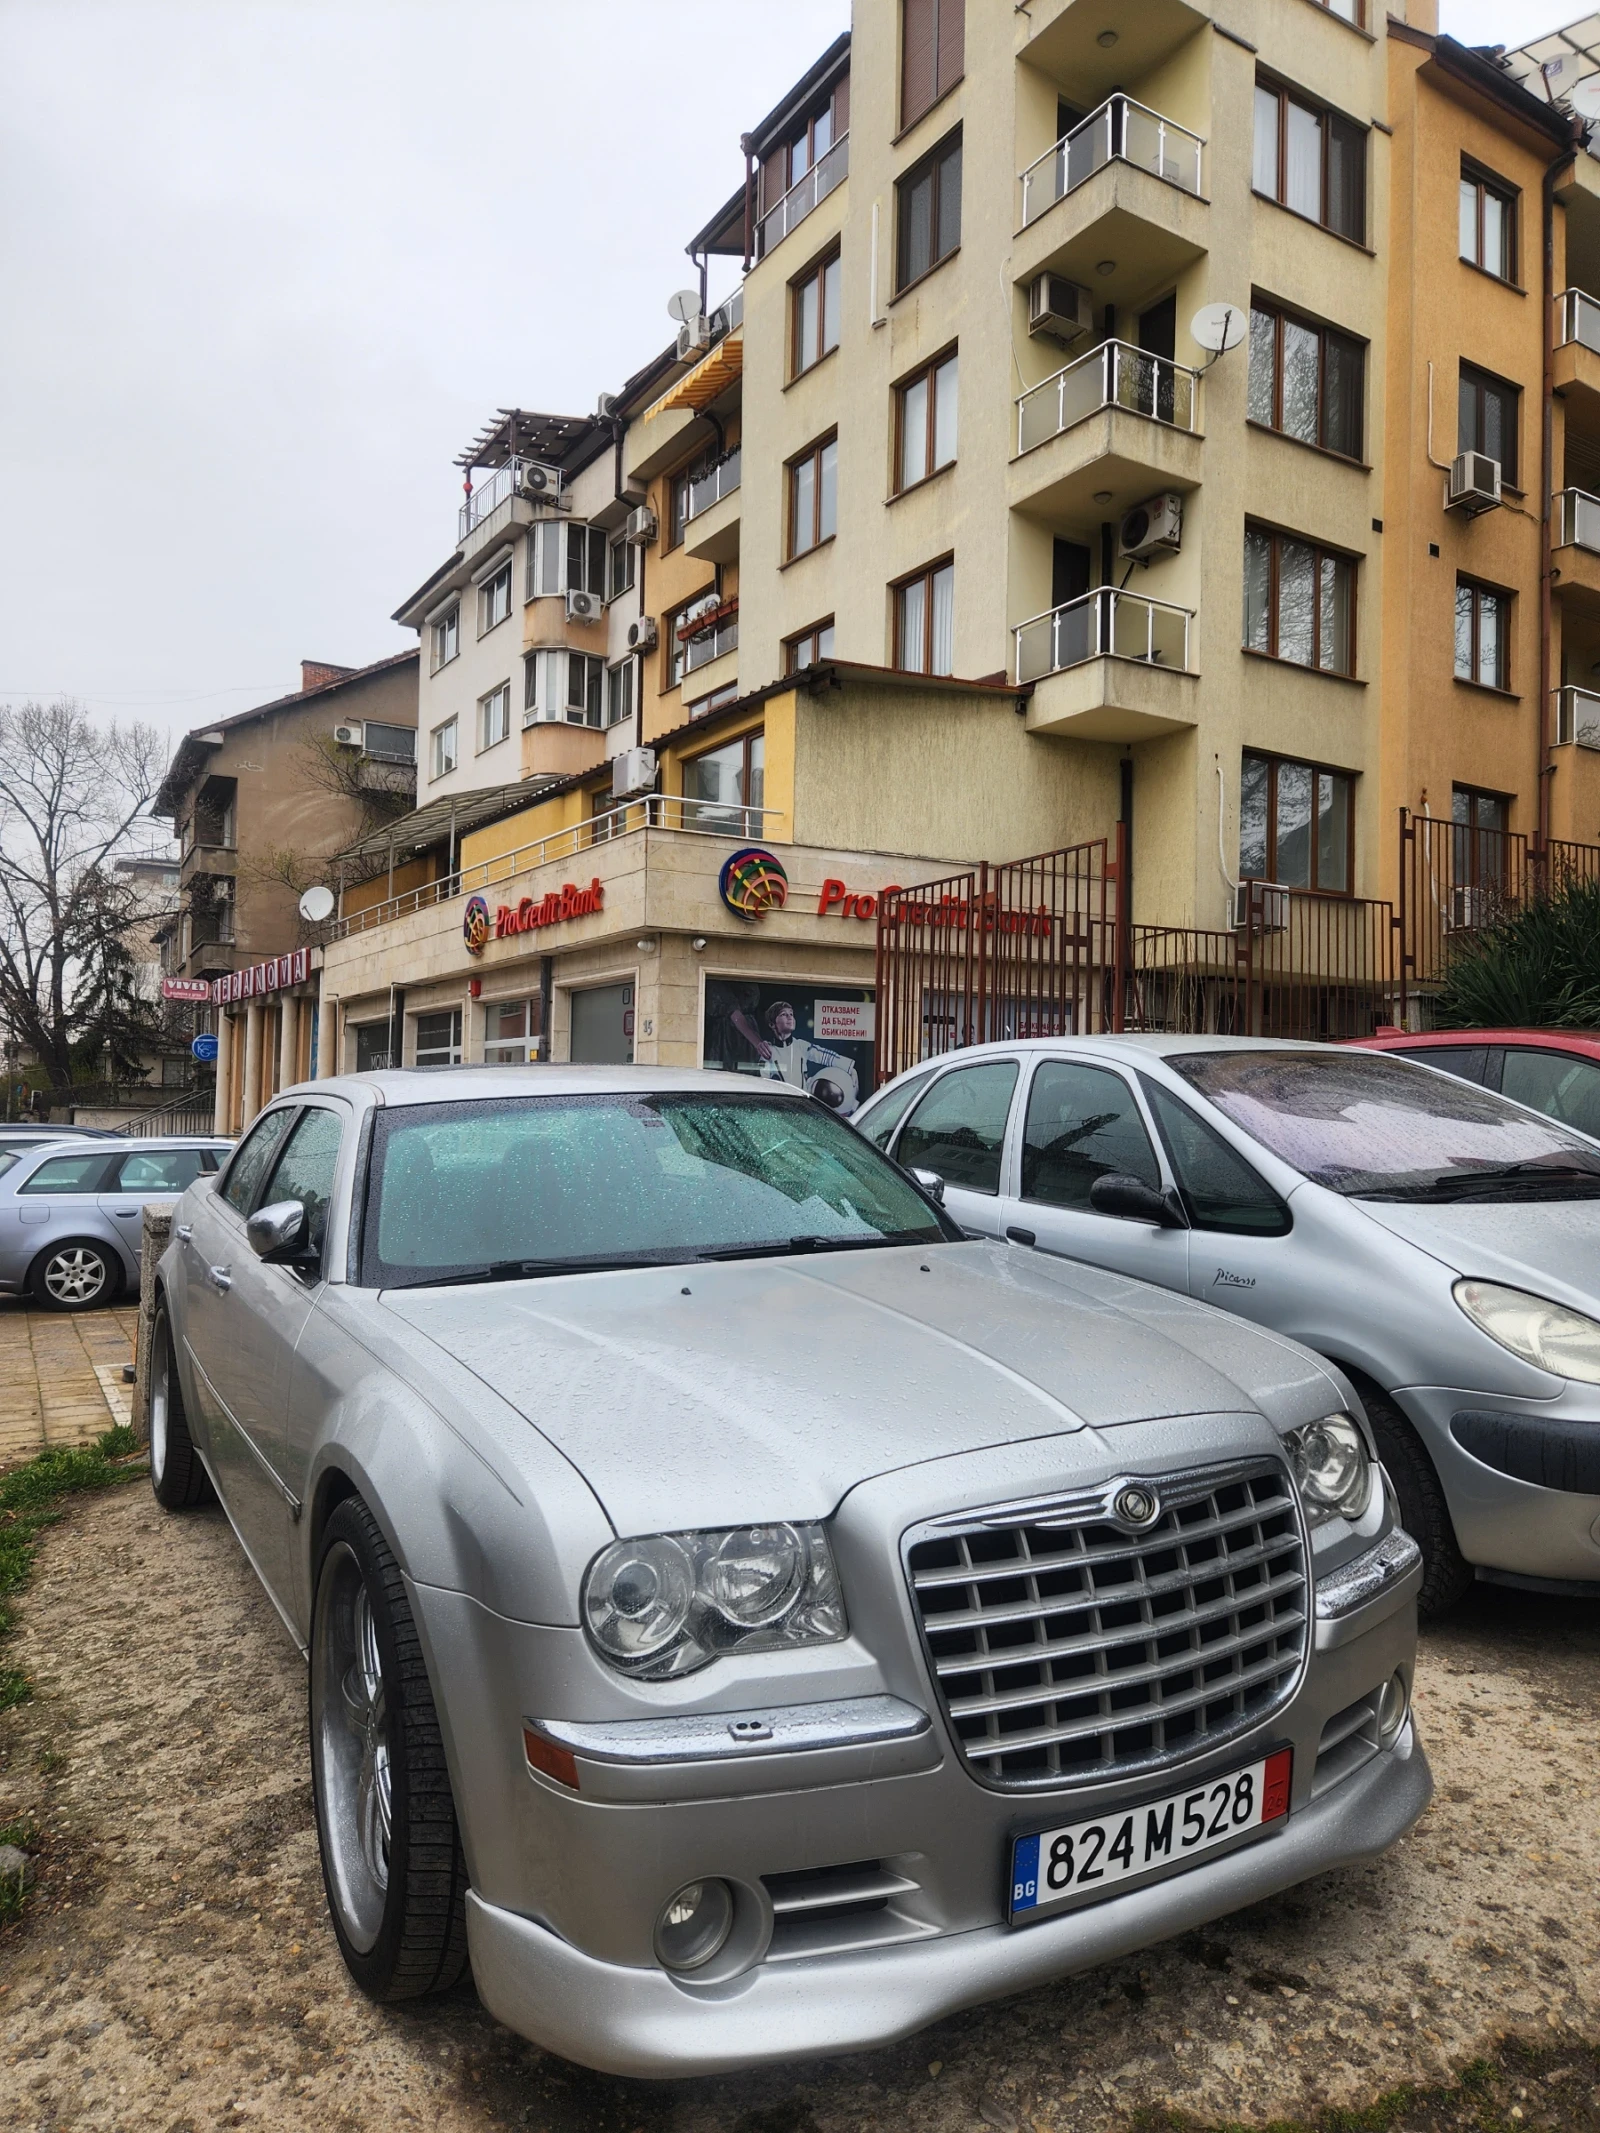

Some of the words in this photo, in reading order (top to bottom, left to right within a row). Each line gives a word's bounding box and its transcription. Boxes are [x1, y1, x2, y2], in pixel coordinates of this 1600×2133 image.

[495, 893, 560, 938] ProCredit
[560, 877, 604, 921] Bank
[167, 980, 206, 991] VIVES
[213, 953, 302, 1004] KERANOVA
[821, 1005, 860, 1015] ОТКАЗВАМЕ
[643, 1019, 653, 1036] 15
[821, 1017, 831, 1025] ДА
[832, 1017, 856, 1026] БЪДЕМ
[821, 1028, 867, 1037] ОБИКНОВЕНИ!
[1212, 1268, 1256, 1287] Picasso
[1014, 1880, 1035, 1901] BG
